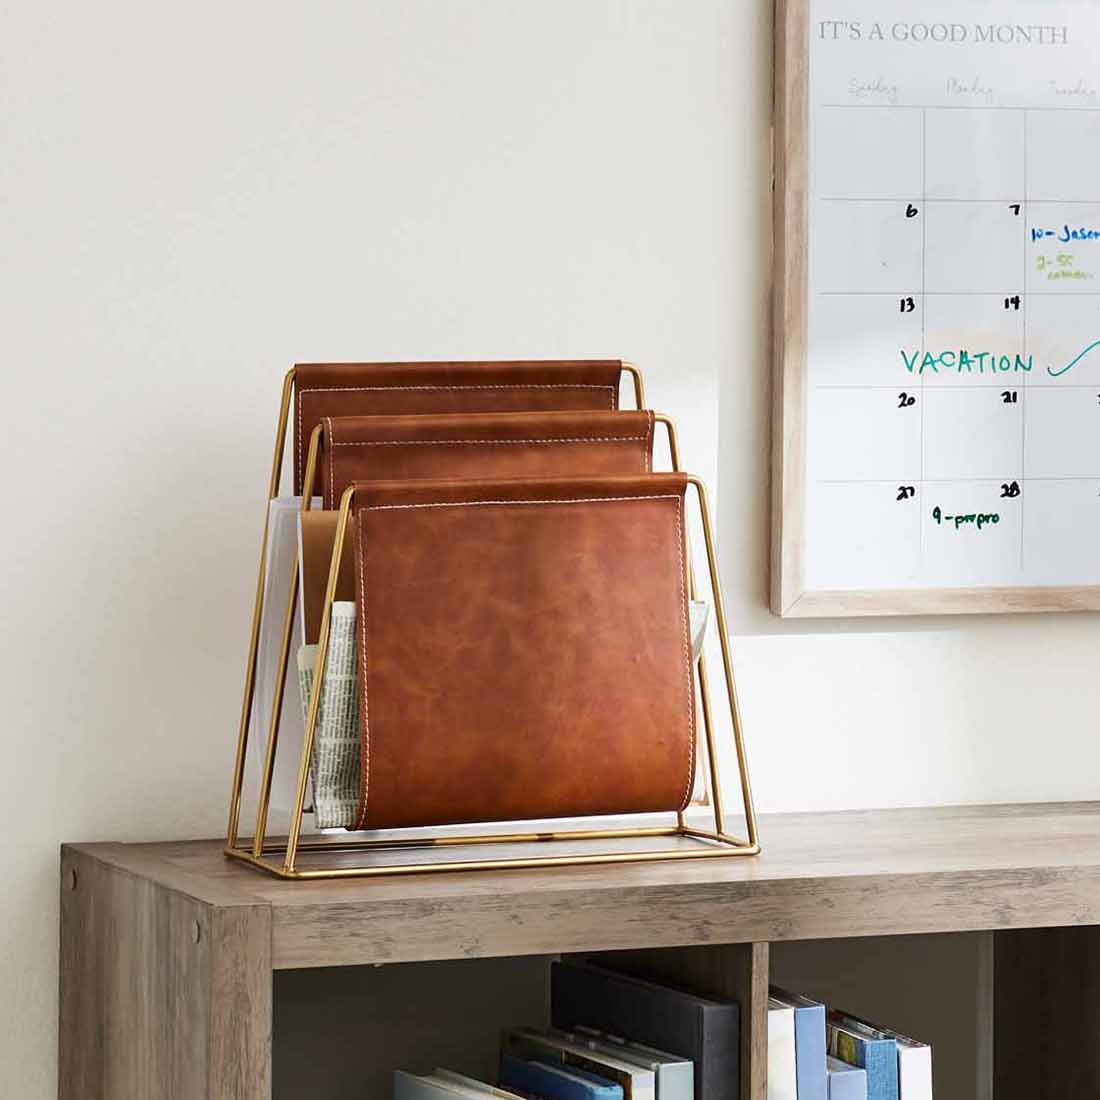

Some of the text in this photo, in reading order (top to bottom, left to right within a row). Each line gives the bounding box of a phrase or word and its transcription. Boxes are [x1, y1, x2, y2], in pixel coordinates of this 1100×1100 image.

[820, 21, 1067, 44] IT'S A GOOD MONTH
[906, 204, 918, 217] 6
[1009, 205, 1020, 215] 7
[901, 297, 915, 312] 13
[1005, 296, 1020, 310] 14
[901, 350, 1032, 374] VACATION
[898, 392, 915, 408] 20
[1001, 391, 1017, 403] 21
[897, 486, 915, 500] 27
[1000, 481, 1020, 497] 28
